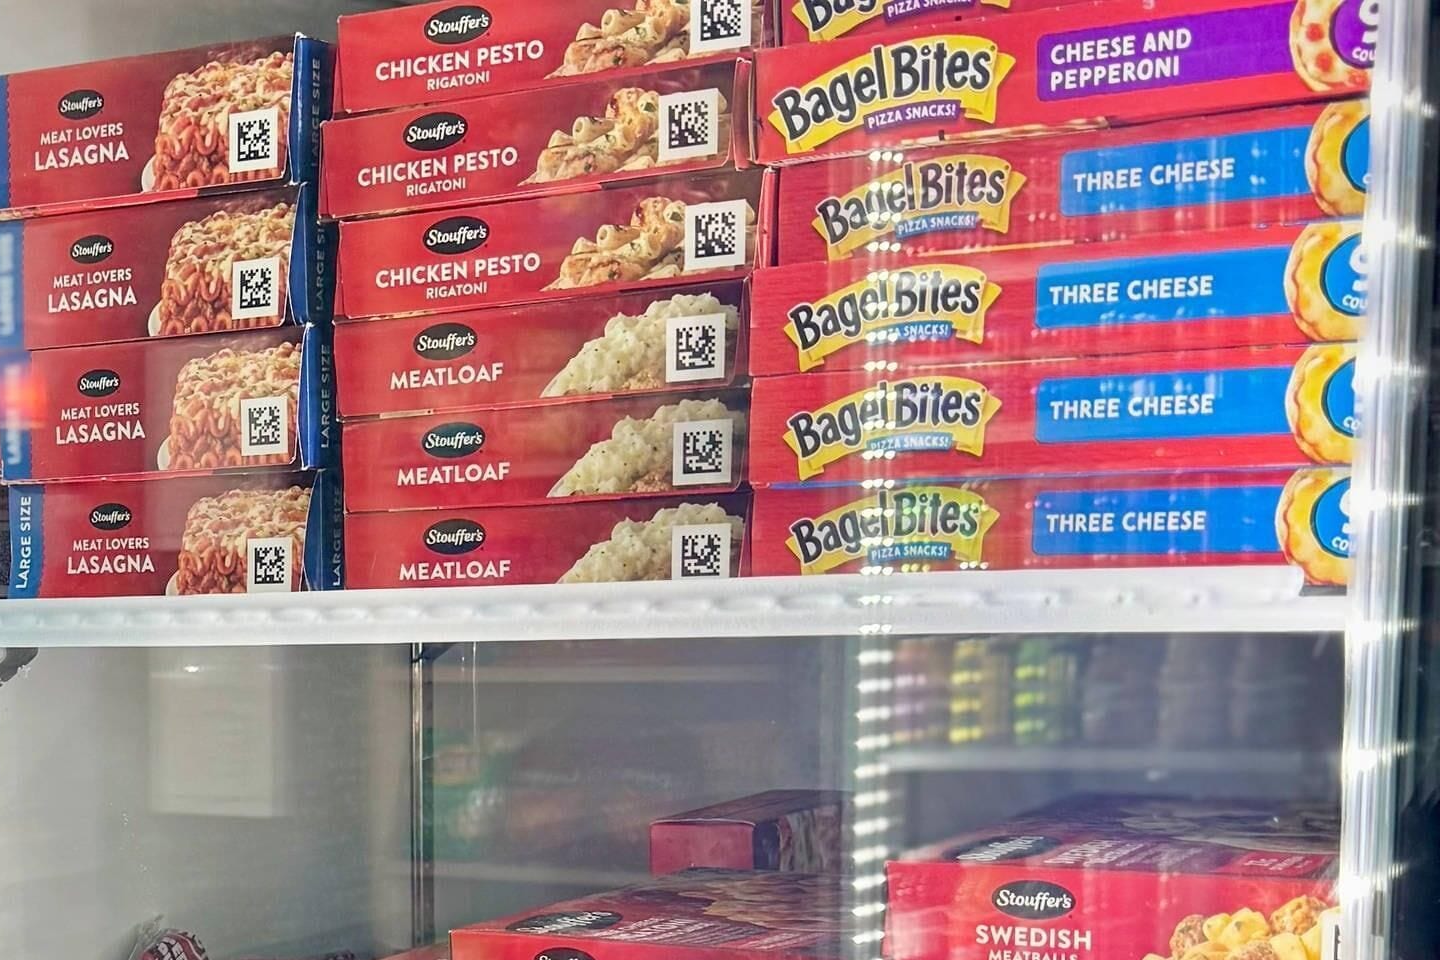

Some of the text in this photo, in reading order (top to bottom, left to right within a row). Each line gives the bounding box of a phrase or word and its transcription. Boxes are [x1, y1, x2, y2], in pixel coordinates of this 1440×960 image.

[427, 13, 489, 35] Stouffer's
[1050, 28, 1192, 65] CHEESE AND
[376, 39, 545, 81] CHICKEN PESTO
[427, 70, 490, 91] RIGATONI
[1050, 55, 1180, 92] PEPPERONI
[773, 42, 992, 141] Bagel Bites
[60, 94, 103, 115] Stouffer's
[868, 104, 956, 129] PIZZA SNACKS!
[40, 123, 123, 145] MEAT LOVERS
[406, 120, 465, 141] Stouffer's
[34, 141, 129, 171] LASAGNA
[358, 146, 518, 187] CHICKEN PESTO
[1073, 158, 1235, 193] THREE CHEESE
[406, 179, 466, 197] RIGATONI
[818, 161, 1006, 244] Bagel Bites
[426, 225, 488, 246] Stouffer's
[898, 215, 976, 235] PIZZA SNACKS!
[72, 239, 113, 259] Stouffer's
[53, 268, 132, 289] MEAT LOVERS
[316, 251, 325, 311] LARGE
[376, 252, 540, 289] CHICKEN PESTO
[48, 286, 137, 313] LASAGNA
[426, 281, 487, 300] RIGATONI
[1050, 275, 1213, 305] THREE CHEESE
[789, 271, 981, 351] Bagel Bites
[903, 324, 948, 336] SNACKS!
[417, 332, 475, 351] Stouffer's
[79, 376, 120, 391] Stouffer's
[390, 363, 504, 390] MEATLOAF
[321, 344, 331, 449] LARGE SIZE
[1050, 394, 1215, 420] THREE CHEESE
[61, 402, 140, 421] MEAT LOVERS
[790, 382, 981, 459] Bagel Bites
[56, 421, 146, 445] LASAGNA
[425, 430, 483, 449] Stouffer's
[903, 436, 948, 447] SNACKS!
[397, 462, 510, 486] MEATLOAF
[91, 510, 131, 524] Stouffer's
[791, 490, 980, 565] Bagel Bites
[1046, 510, 1207, 532] THREE CHEESE
[16, 496, 32, 589] LARGE SIZE
[73, 537, 150, 552] MEAT LOVERS
[426, 528, 484, 545] Stouffer's
[871, 545, 948, 560] PIZZA SNACKS!
[67, 553, 155, 575] LASAGNA
[399, 560, 511, 581] MEATLOAF
[996, 889, 1072, 910] Stouffer's
[975, 924, 1092, 950] SWEDISH
